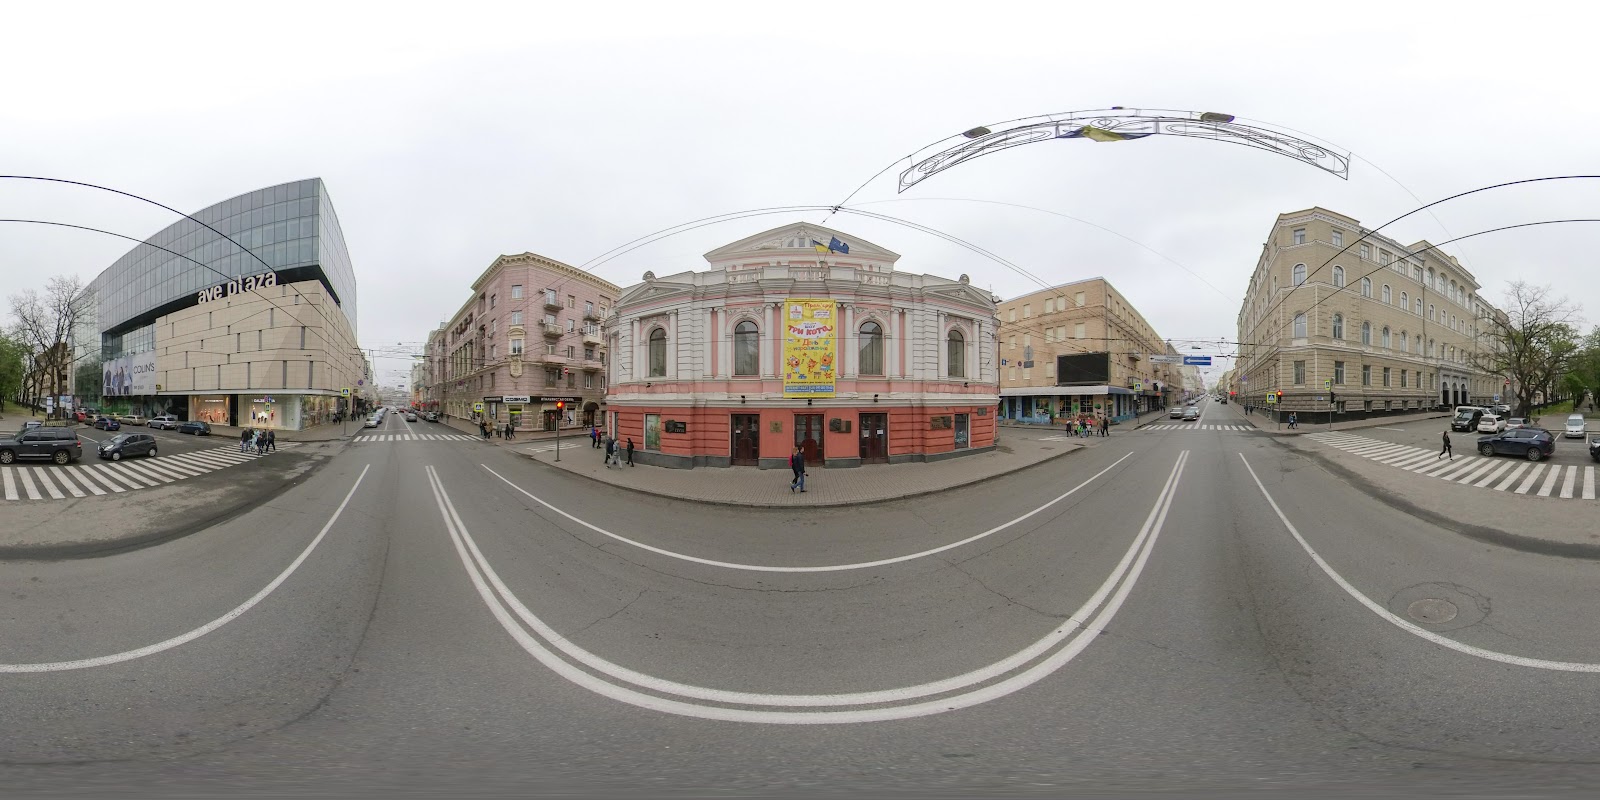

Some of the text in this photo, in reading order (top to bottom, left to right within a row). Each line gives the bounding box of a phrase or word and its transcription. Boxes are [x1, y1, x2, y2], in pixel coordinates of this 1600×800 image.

[198, 272, 276, 304] ave plaza
[788, 324, 804, 334] ТРИ
[134, 362, 154, 374] COLIN'S
